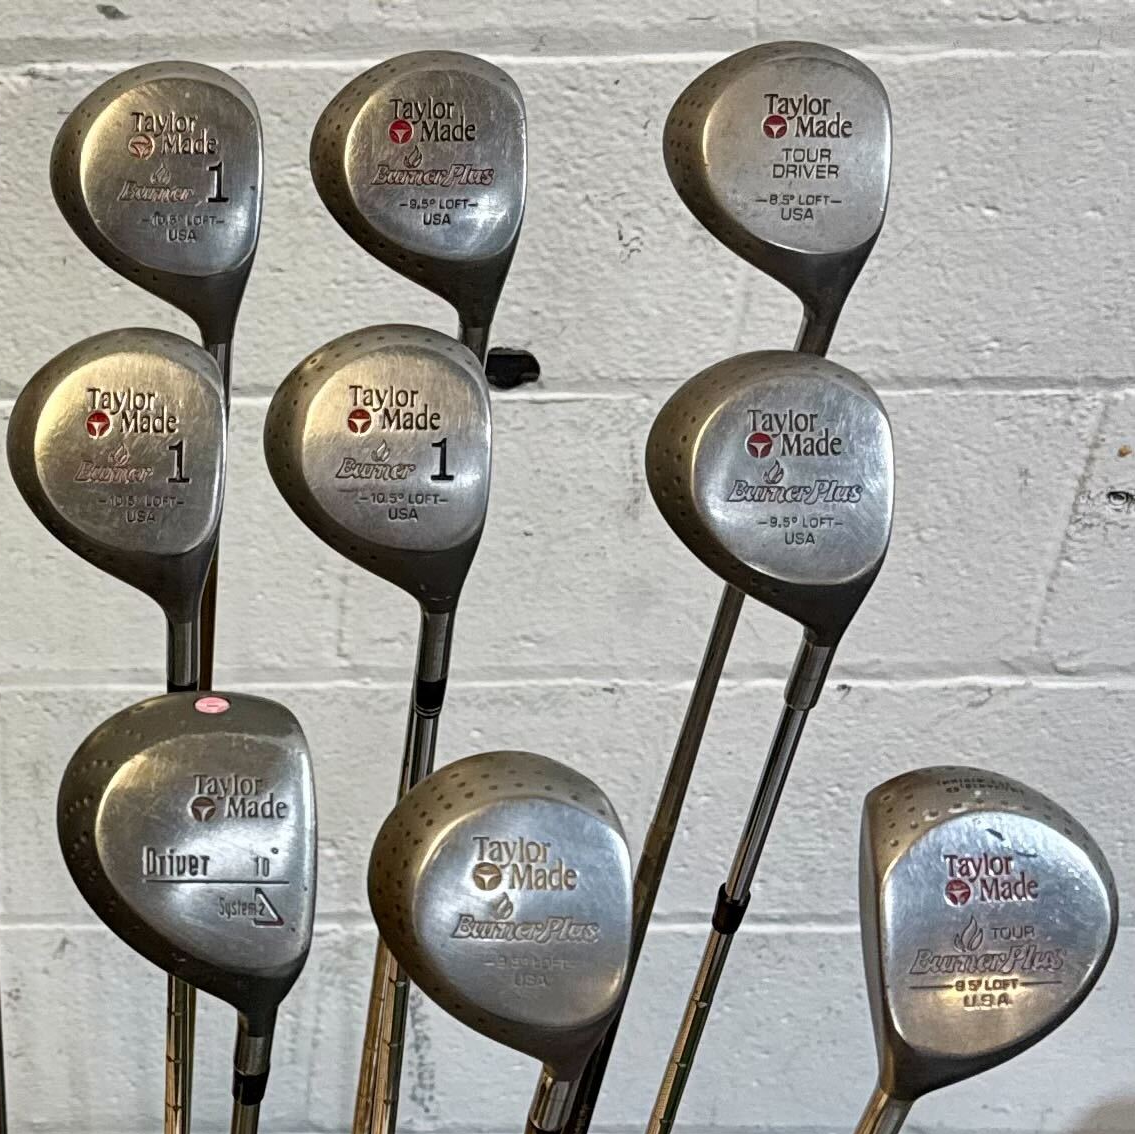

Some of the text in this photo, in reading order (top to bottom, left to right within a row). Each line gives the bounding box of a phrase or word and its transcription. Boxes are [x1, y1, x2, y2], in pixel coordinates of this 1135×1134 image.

[389, 96, 454, 124] Taylor
[764, 93, 832, 120] Taylor
[131, 112, 198, 137] Taylor
[420, 116, 476, 142] Made
[795, 112, 853, 138] Made
[161, 129, 219, 154] Made
[781, 148, 831, 163] TOUR
[206, 160, 229, 203] 1
[772, 164, 840, 179] DRIVER
[423, 213, 451, 226] USA
[781, 208, 814, 221] USA
[168, 229, 196, 242] USA
[87, 387, 158, 415] Taylor
[349, 385, 418, 412] Taylor
[120, 406, 179, 434] Made
[382, 404, 440, 431] Made
[747, 409, 817, 438] Taylor
[781, 428, 842, 457] Made
[167, 440, 191, 483] 1
[336, 437, 454, 481] Burner 1
[125, 510, 156, 524] USA
[388, 508, 418, 520] USA
[785, 532, 815, 545] USA
[193, 774, 263, 799] Taylor
[224, 793, 288, 820] Made
[142, 846, 210, 877] Driver
[473, 836, 551, 869] Taylor
[509, 859, 578, 890] Made
[943, 853, 1013, 883] Taylor
[980, 872, 1039, 901] Made
[991, 926, 1035, 940] TOUR
